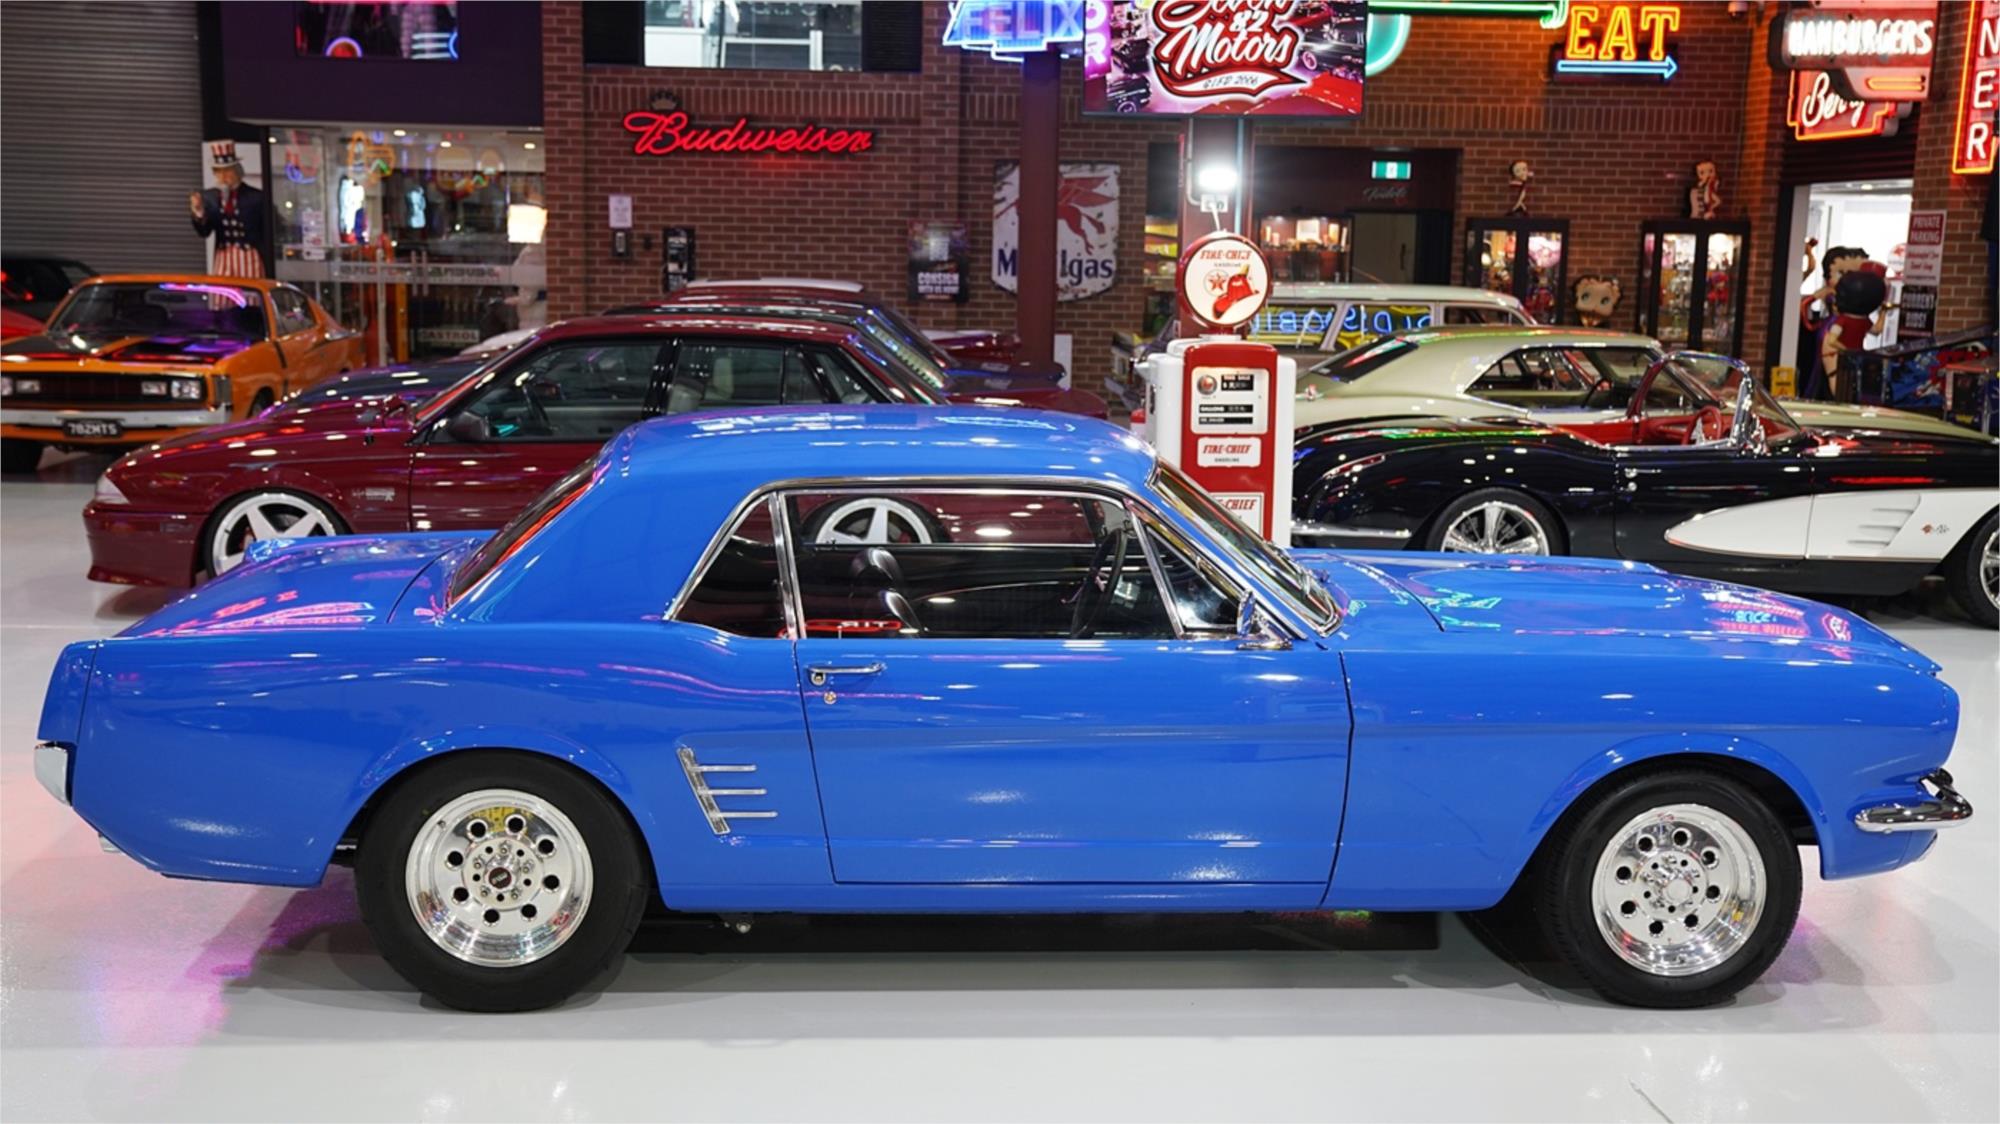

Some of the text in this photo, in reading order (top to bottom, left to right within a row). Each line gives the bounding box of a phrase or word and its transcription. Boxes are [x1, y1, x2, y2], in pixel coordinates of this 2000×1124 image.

[964, 0, 1079, 40] FELIX
[1229, 10, 1269, 32] 82
[1566, 6, 1680, 60] EAT
[1788, 18, 1934, 56] HAMBURGERS
[1160, 22, 1293, 77] Motors
[623, 111, 873, 155] Budweiser
[1913, 215, 1941, 229] PRIVATE
[997, 248, 1114, 287] Mlgas
[1203, 445, 1252, 454] FIRE-CHIEF
